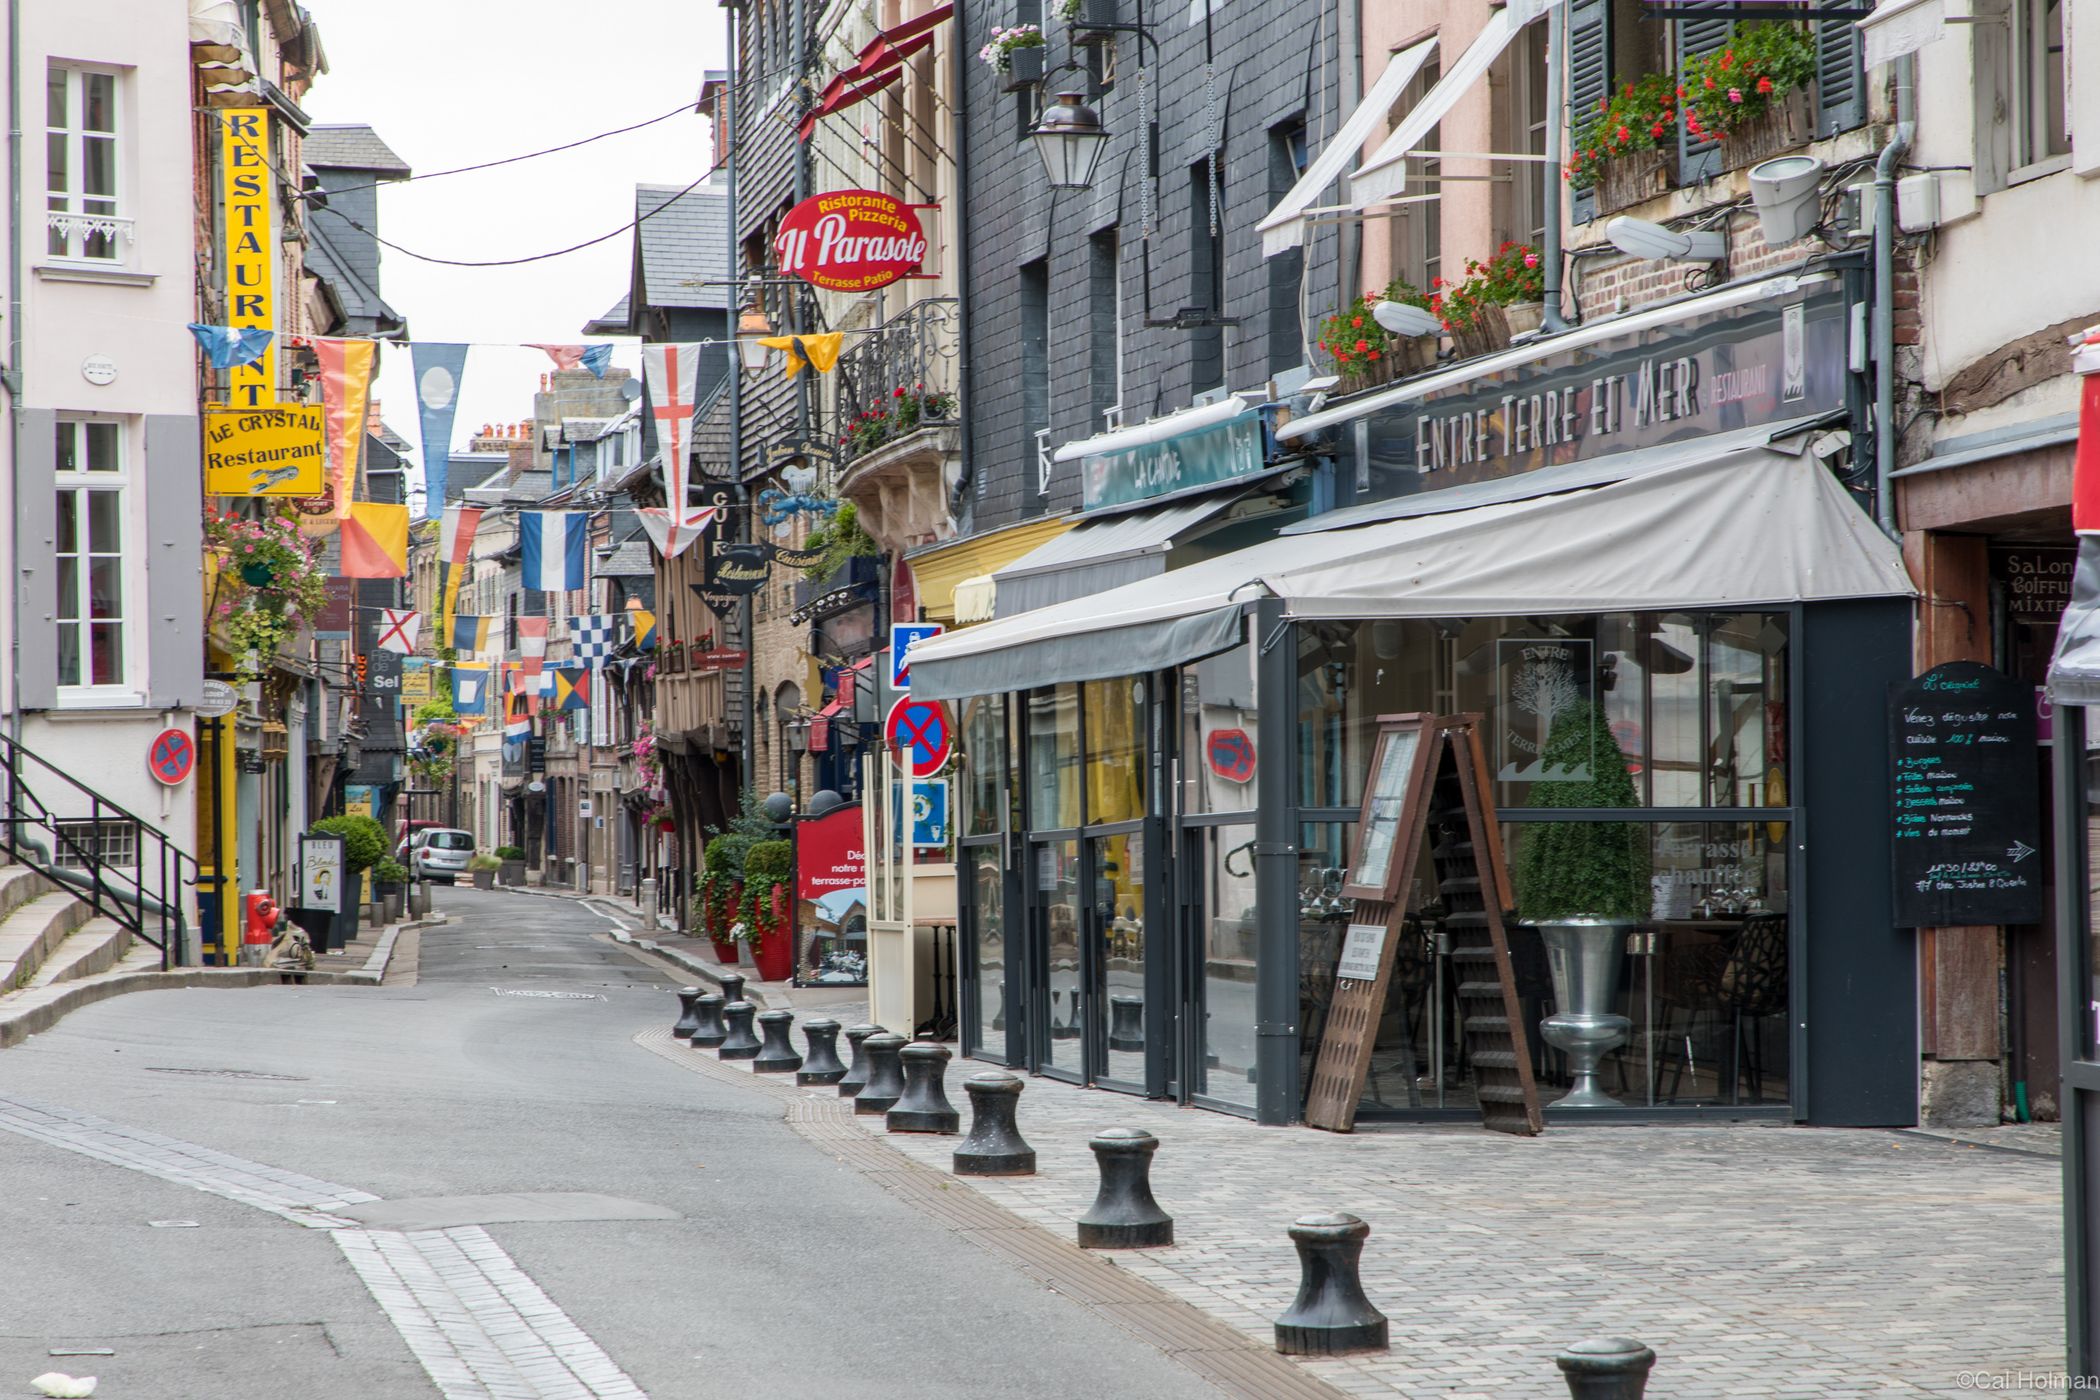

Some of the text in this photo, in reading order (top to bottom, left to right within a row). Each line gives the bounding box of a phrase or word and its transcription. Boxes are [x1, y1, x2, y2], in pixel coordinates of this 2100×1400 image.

[818, 195, 897, 214] Ristorante
[849, 207, 908, 233] Pizzeria
[778, 213, 927, 272] Il Parasole
[230, 114, 267, 406] RESTAURNT
[812, 269, 894, 288] Terrasse Patio
[1416, 357, 1767, 474] ENTRE TERRE ET MER RESTAURANT
[209, 412, 321, 444] LE CRYSTAL
[208, 440, 323, 469] Restaurant
[1520, 645, 1570, 661] ENTRE
[373, 675, 399, 688] Sel
[831, 864, 857, 873] notre
[1658, 864, 1757, 885] chauffée
